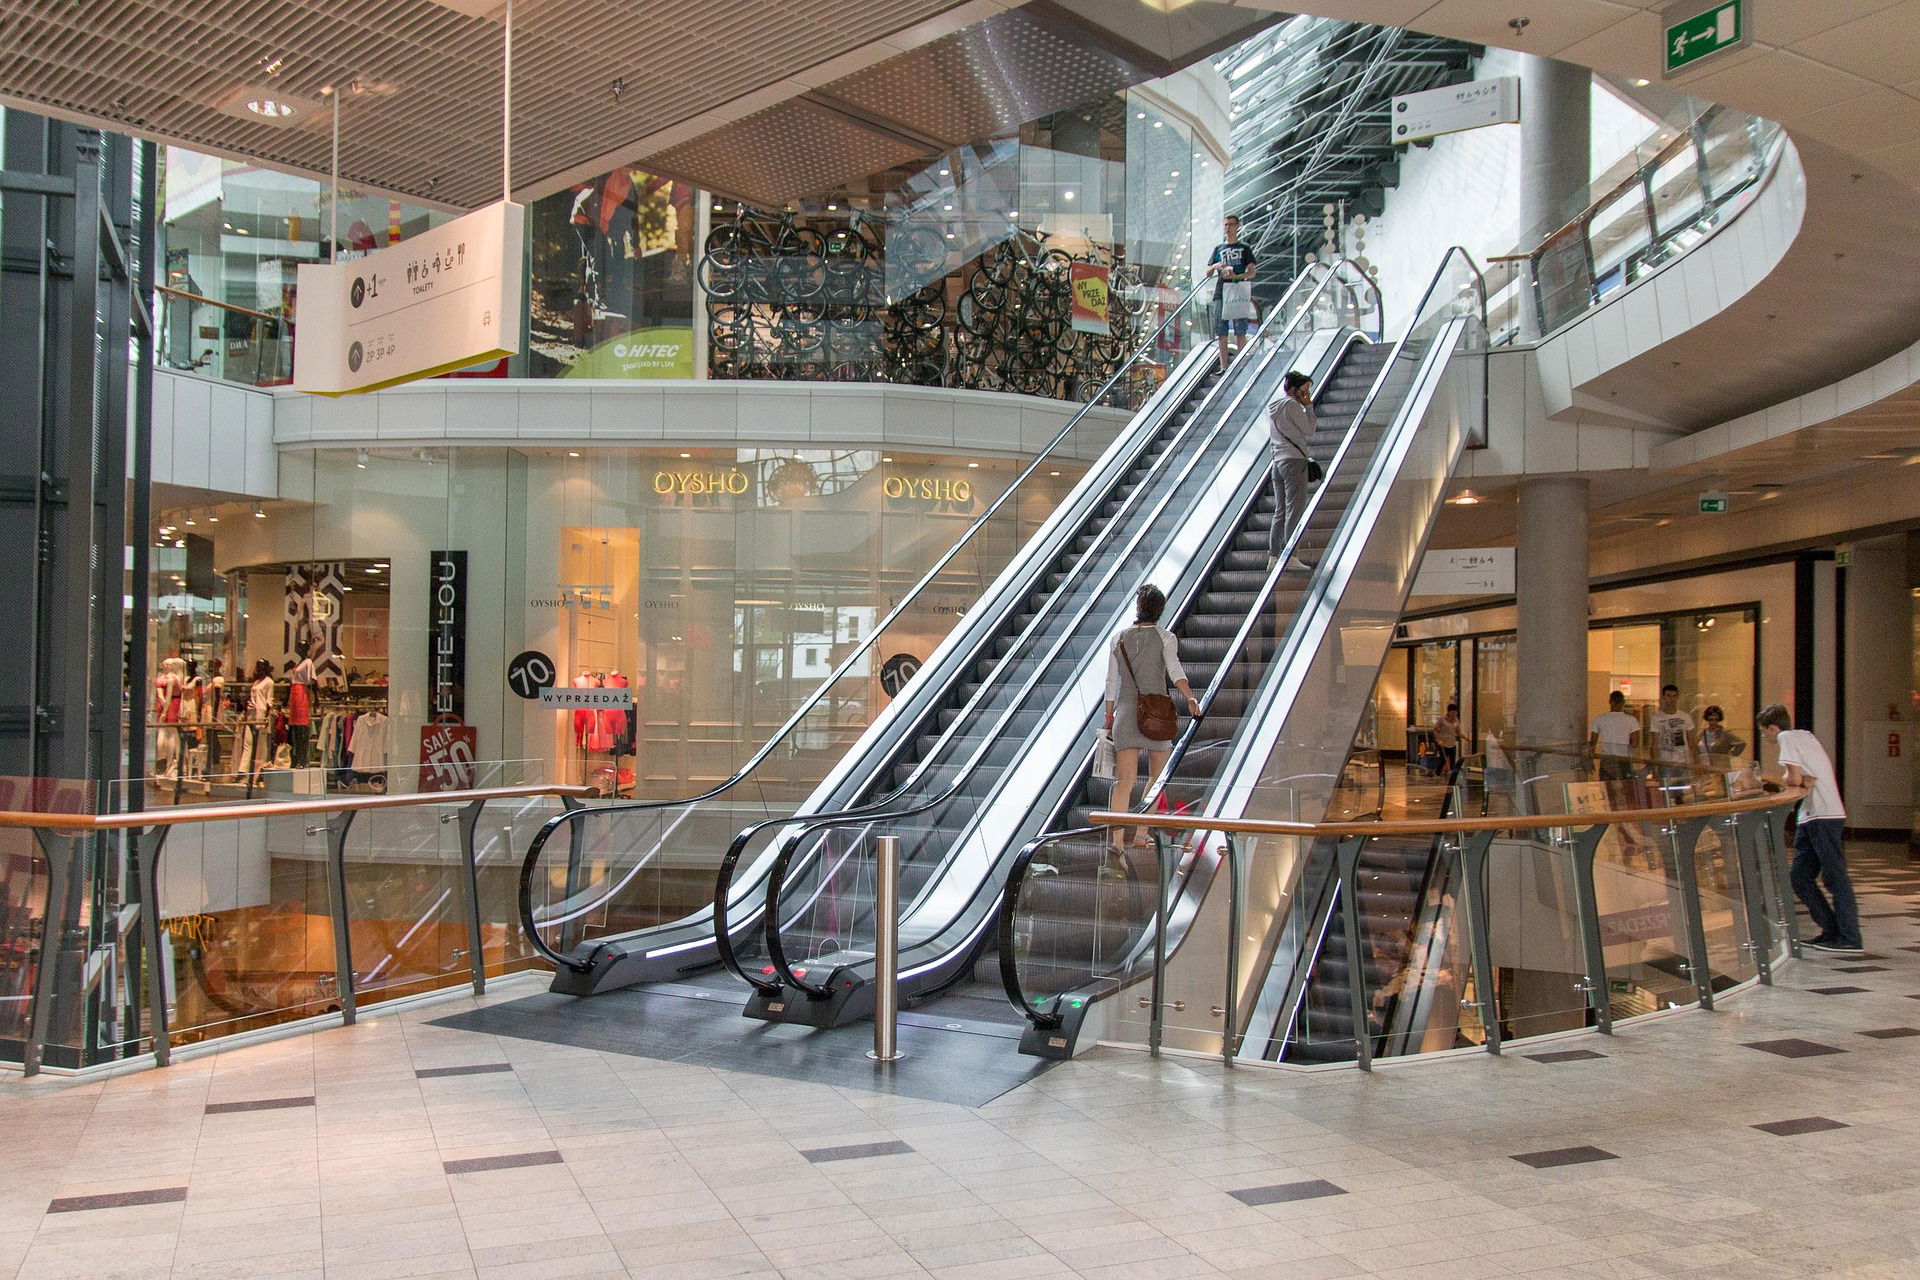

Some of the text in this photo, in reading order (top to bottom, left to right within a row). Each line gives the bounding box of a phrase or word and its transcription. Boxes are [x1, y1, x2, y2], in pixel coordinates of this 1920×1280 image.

[367, 273, 378, 298] +1
[412, 282, 434, 295] TOALETY
[1083, 289, 1100, 299] PRZE
[366, 344, 396, 363] 2P 3P 4P
[653, 471, 749, 494] OYSHO
[883, 477, 970, 502] OYSHO
[531, 600, 565, 608] OYSHO
[645, 600, 680, 608] OYSHO
[790, 602, 825, 611] OYSHO
[437, 561, 456, 713] ETTE LOU
[543, 693, 629, 703] WYPRZEDAŻ
[423, 727, 455, 753] SALE
